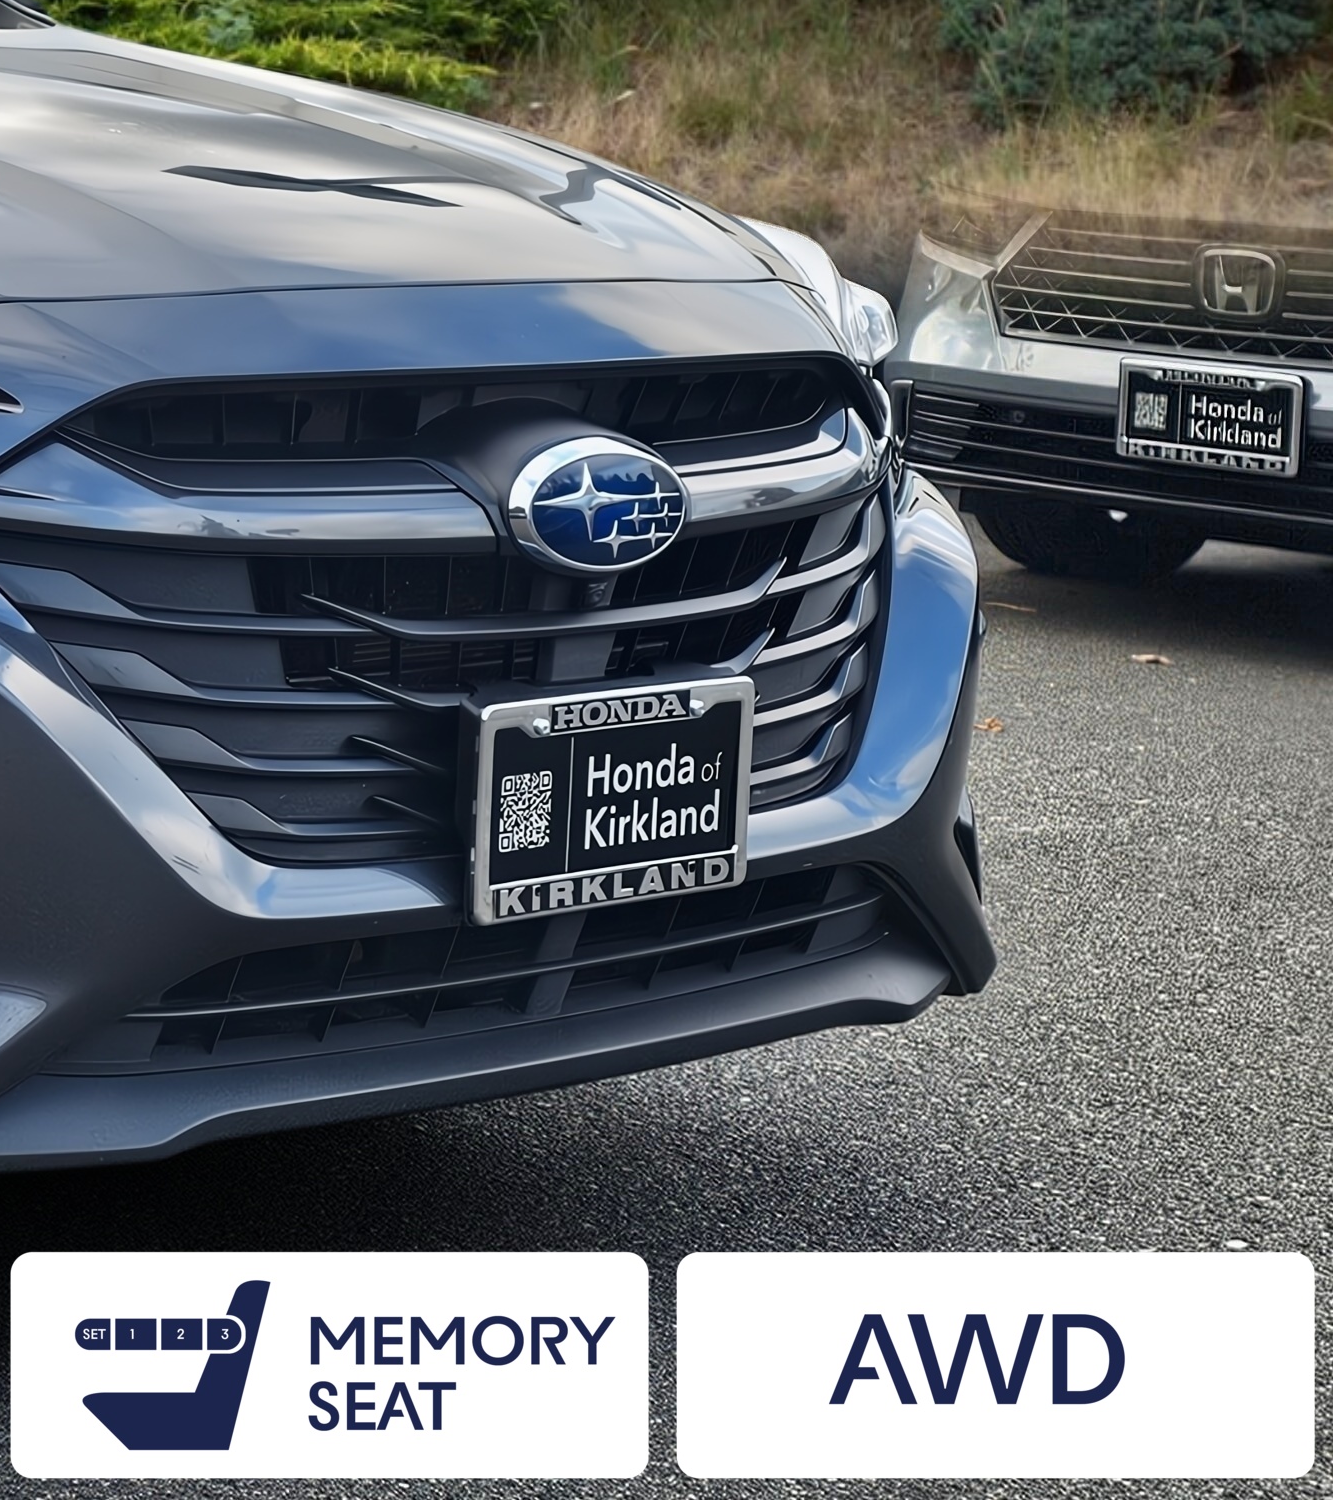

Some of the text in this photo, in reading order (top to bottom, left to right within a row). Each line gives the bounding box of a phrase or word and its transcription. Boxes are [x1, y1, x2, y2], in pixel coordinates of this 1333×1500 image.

[1190, 393, 1264, 423] Honda
[553, 694, 687, 731] HONDA
[586, 743, 723, 798] Honda of
[583, 788, 721, 850] Kirkland
[499, 857, 730, 916] KIRKLAND
